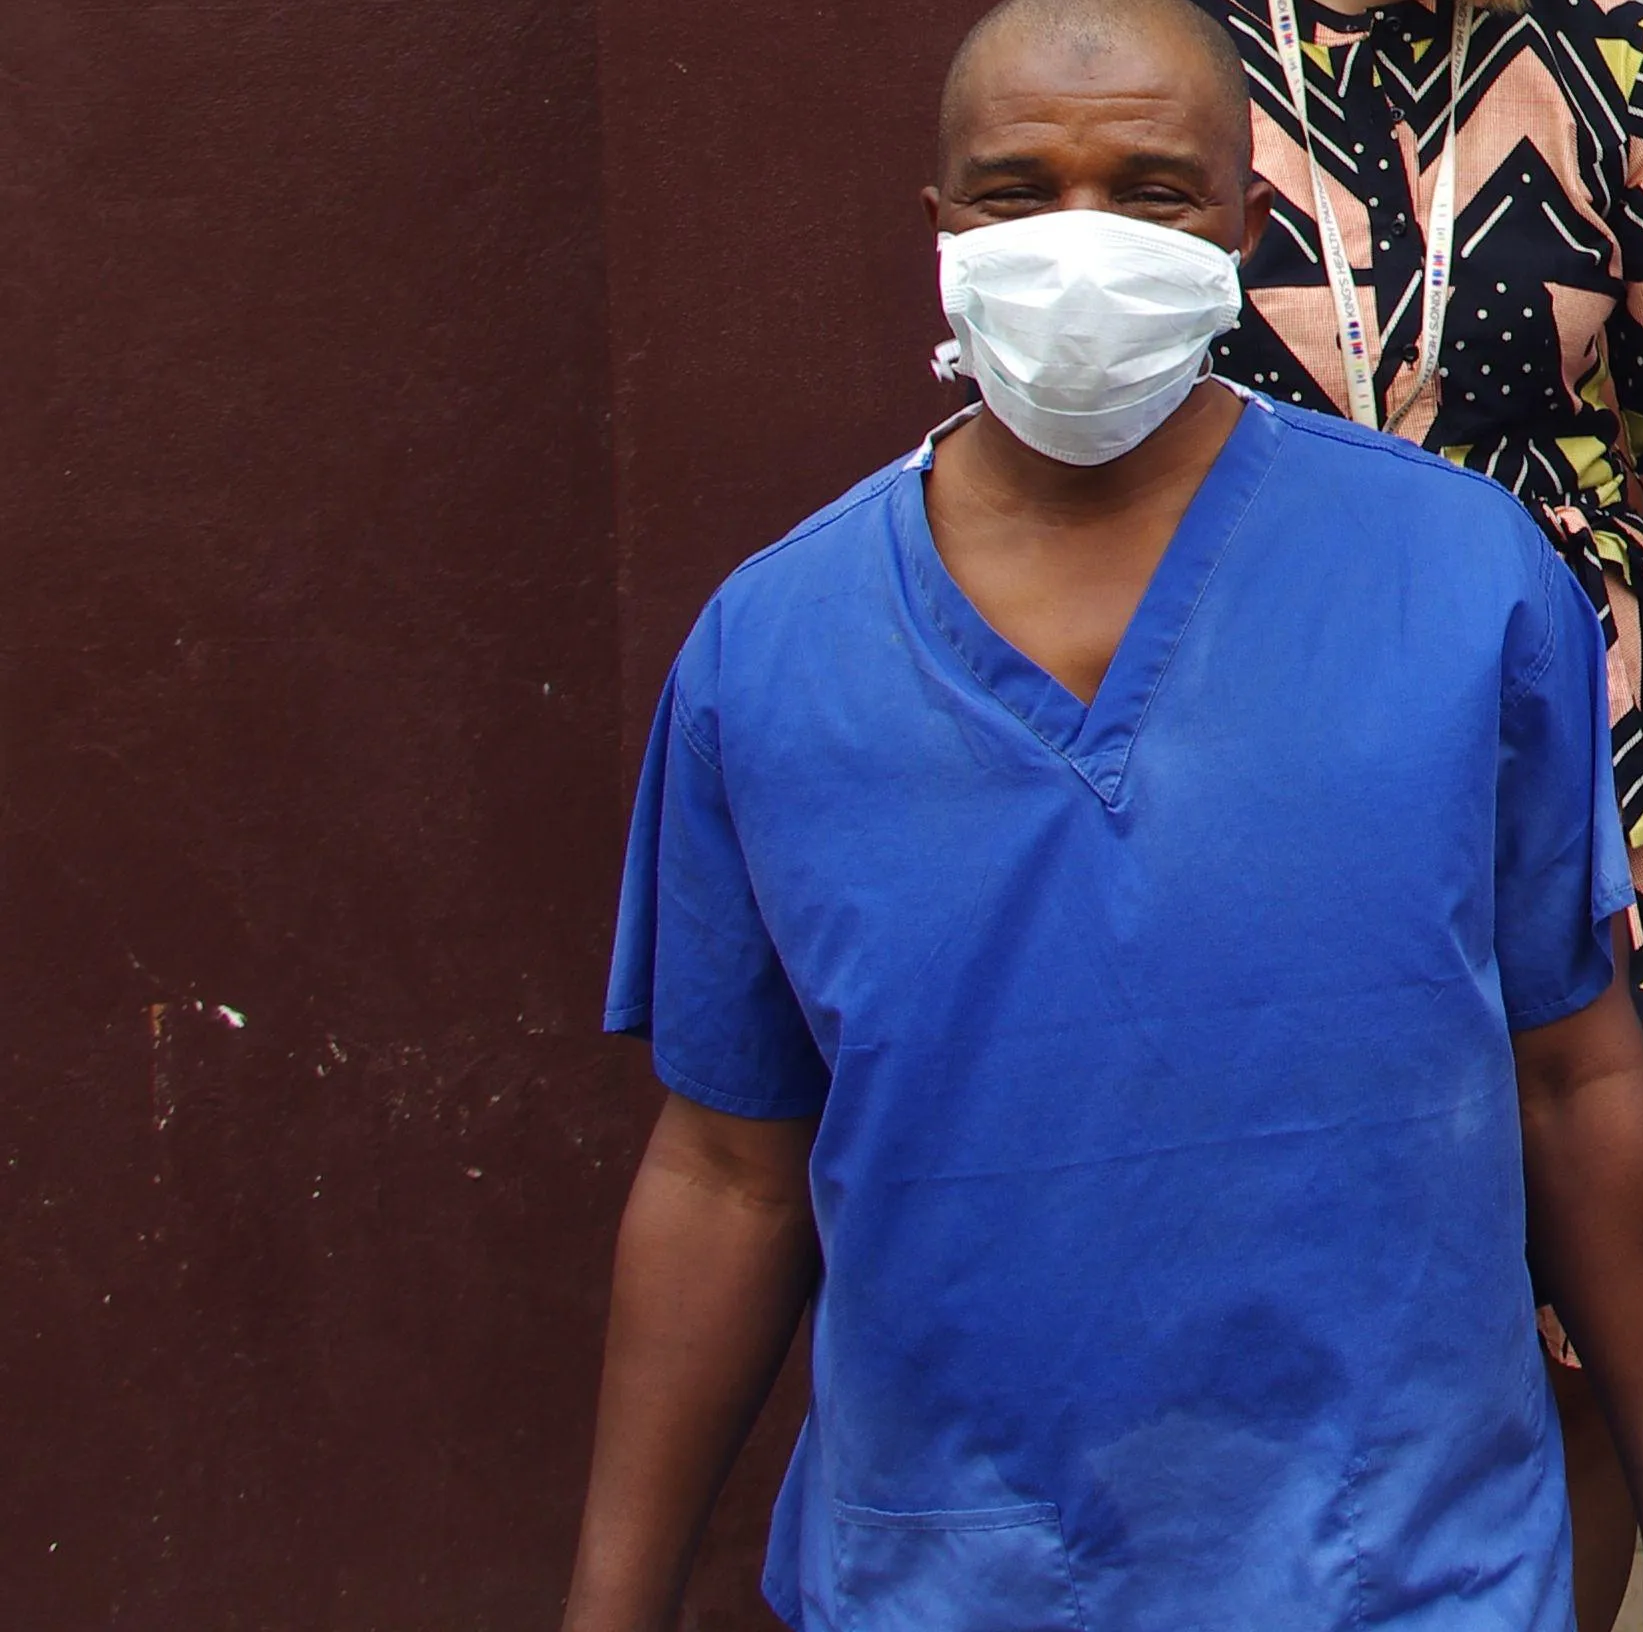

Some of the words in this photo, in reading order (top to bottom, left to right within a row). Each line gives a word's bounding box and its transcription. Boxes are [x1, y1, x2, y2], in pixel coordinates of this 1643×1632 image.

[1328, 226, 1348, 271] HEALTH
[1338, 277, 1358, 319] KING'S
[1428, 289, 1443, 333] KING'S
[1422, 333, 1439, 384] HEALTH
